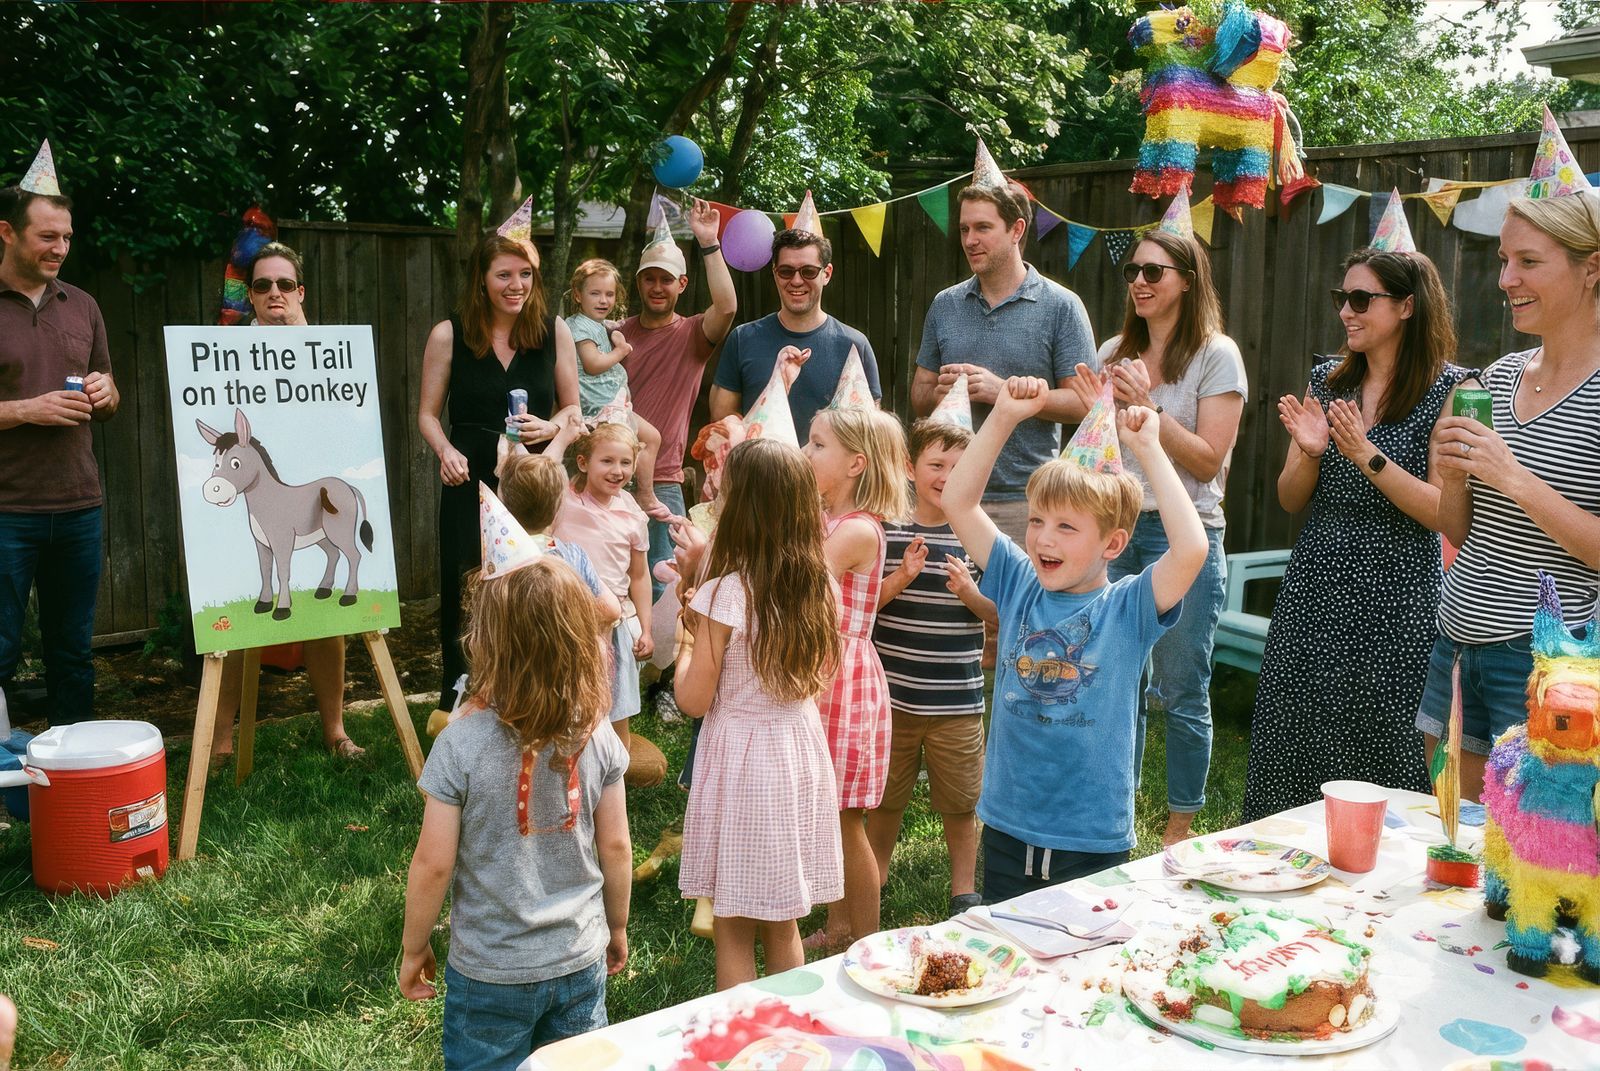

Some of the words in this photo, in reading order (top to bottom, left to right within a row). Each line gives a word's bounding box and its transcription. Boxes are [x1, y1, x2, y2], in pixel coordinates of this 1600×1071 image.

[191, 342, 240, 372] Pin
[249, 341, 296, 371] the
[304, 340, 353, 370] Tail
[182, 386, 217, 407] on
[223, 379, 267, 405] the
[275, 377, 368, 408] Donkey
